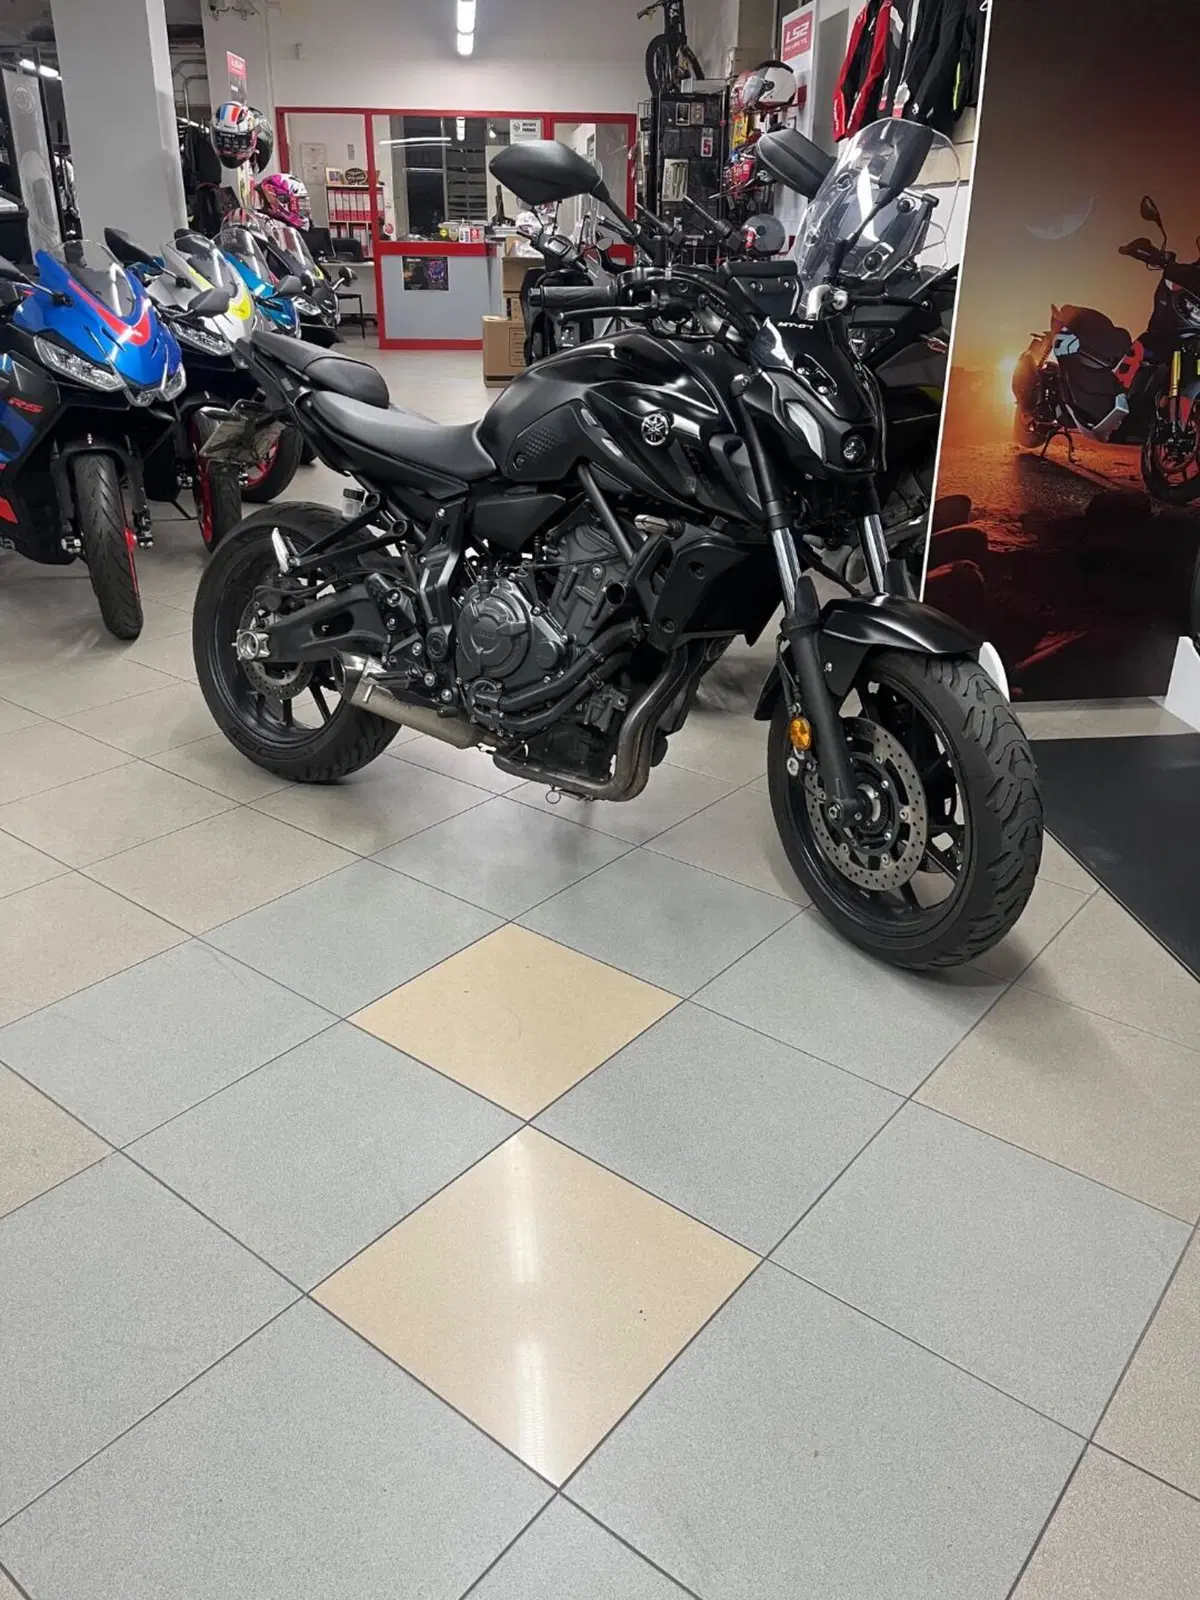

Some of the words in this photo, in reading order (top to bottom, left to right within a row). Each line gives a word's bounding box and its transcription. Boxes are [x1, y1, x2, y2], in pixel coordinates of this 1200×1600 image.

[785, 20, 810, 45] LS2
[777, 321, 814, 330] MT-07
[8, 396, 45, 413] RS
